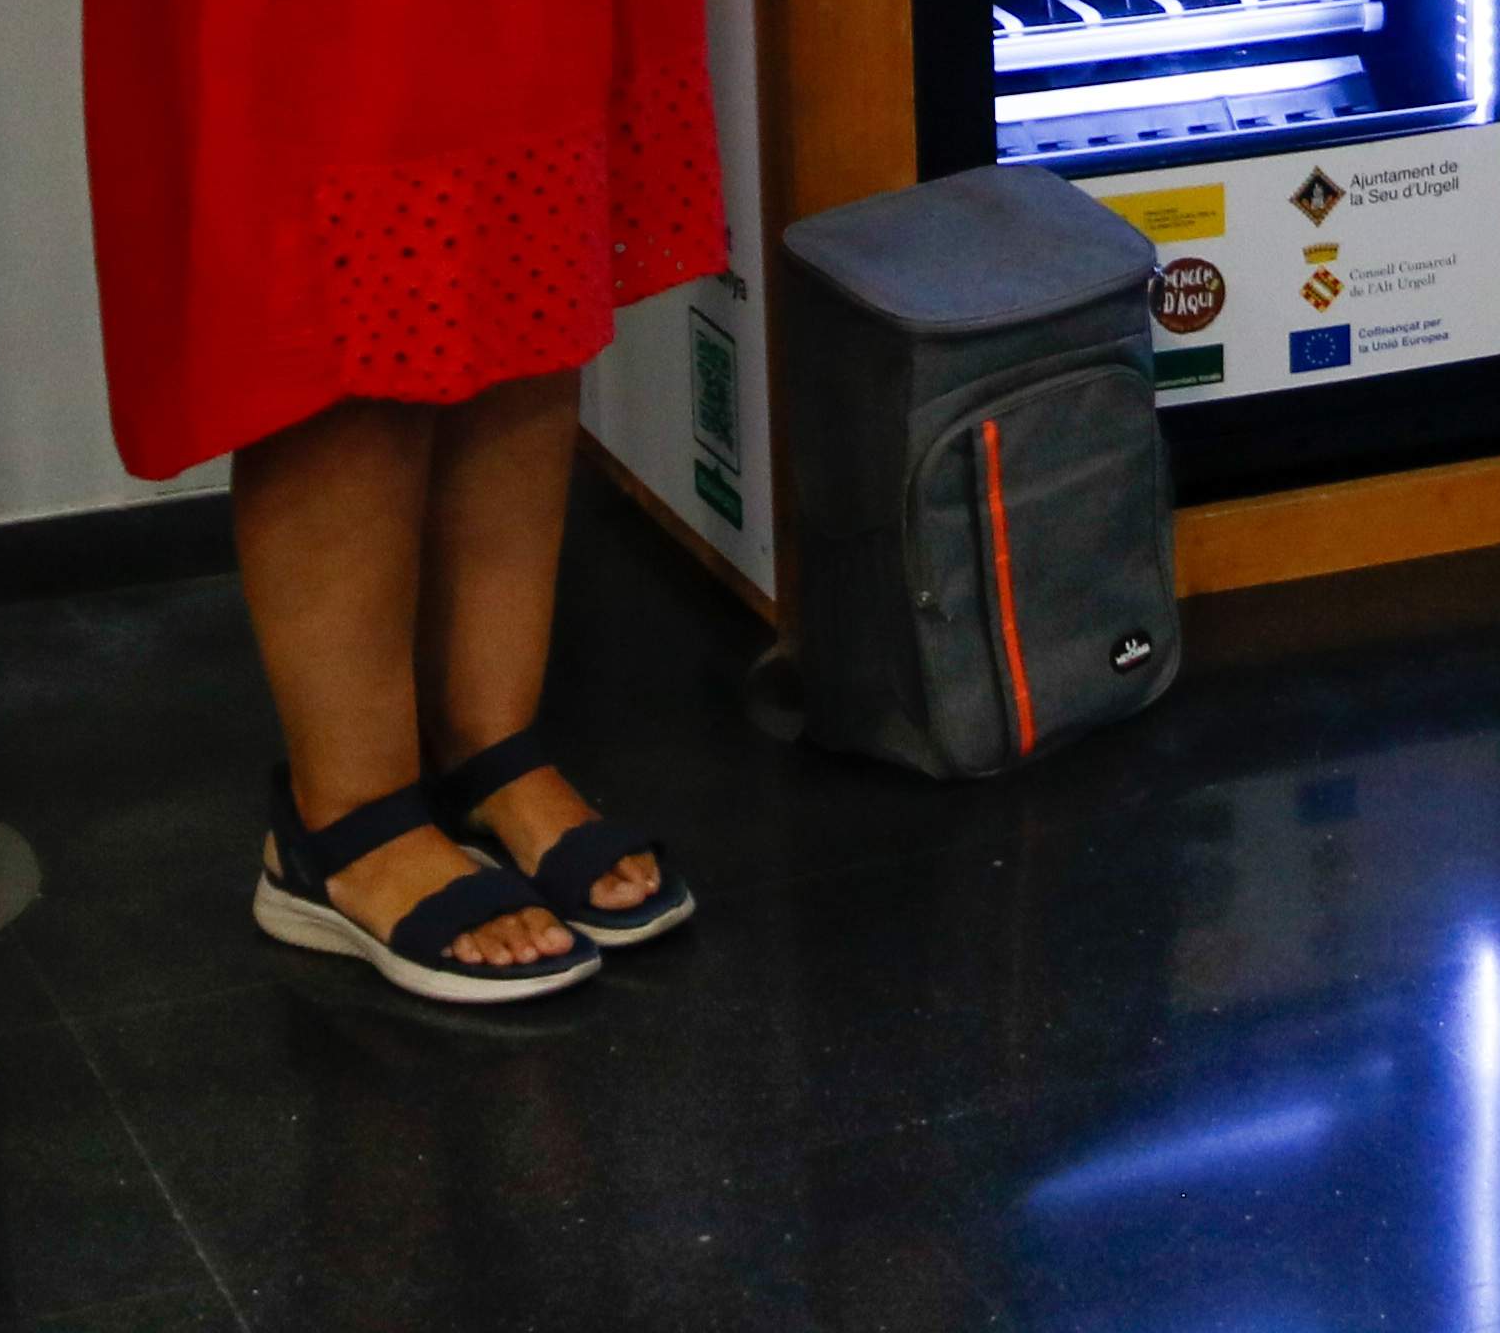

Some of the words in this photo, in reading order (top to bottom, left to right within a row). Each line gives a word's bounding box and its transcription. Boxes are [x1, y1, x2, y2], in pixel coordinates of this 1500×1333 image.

[1349, 162, 1435, 190] Ajuntament
[1439, 159, 1458, 175] de
[1349, 192, 1363, 206] la
[1368, 188, 1398, 204] Seu
[1402, 176, 1459, 198] d'Urgell
[1349, 262, 1395, 281] Consell
[1398, 252, 1457, 273] Comarcal
[1349, 285, 1364, 298] de
[1368, 280, 1393, 295] l'Alt
[1397, 273, 1436, 291] Urgell
[1358, 320, 1420, 340] Cofinançat
[1423, 318, 1442, 331] per
[1358, 344, 1369, 353] la
[1371, 339, 1398, 352] Unió
[1401, 332, 1449, 348] Europea
